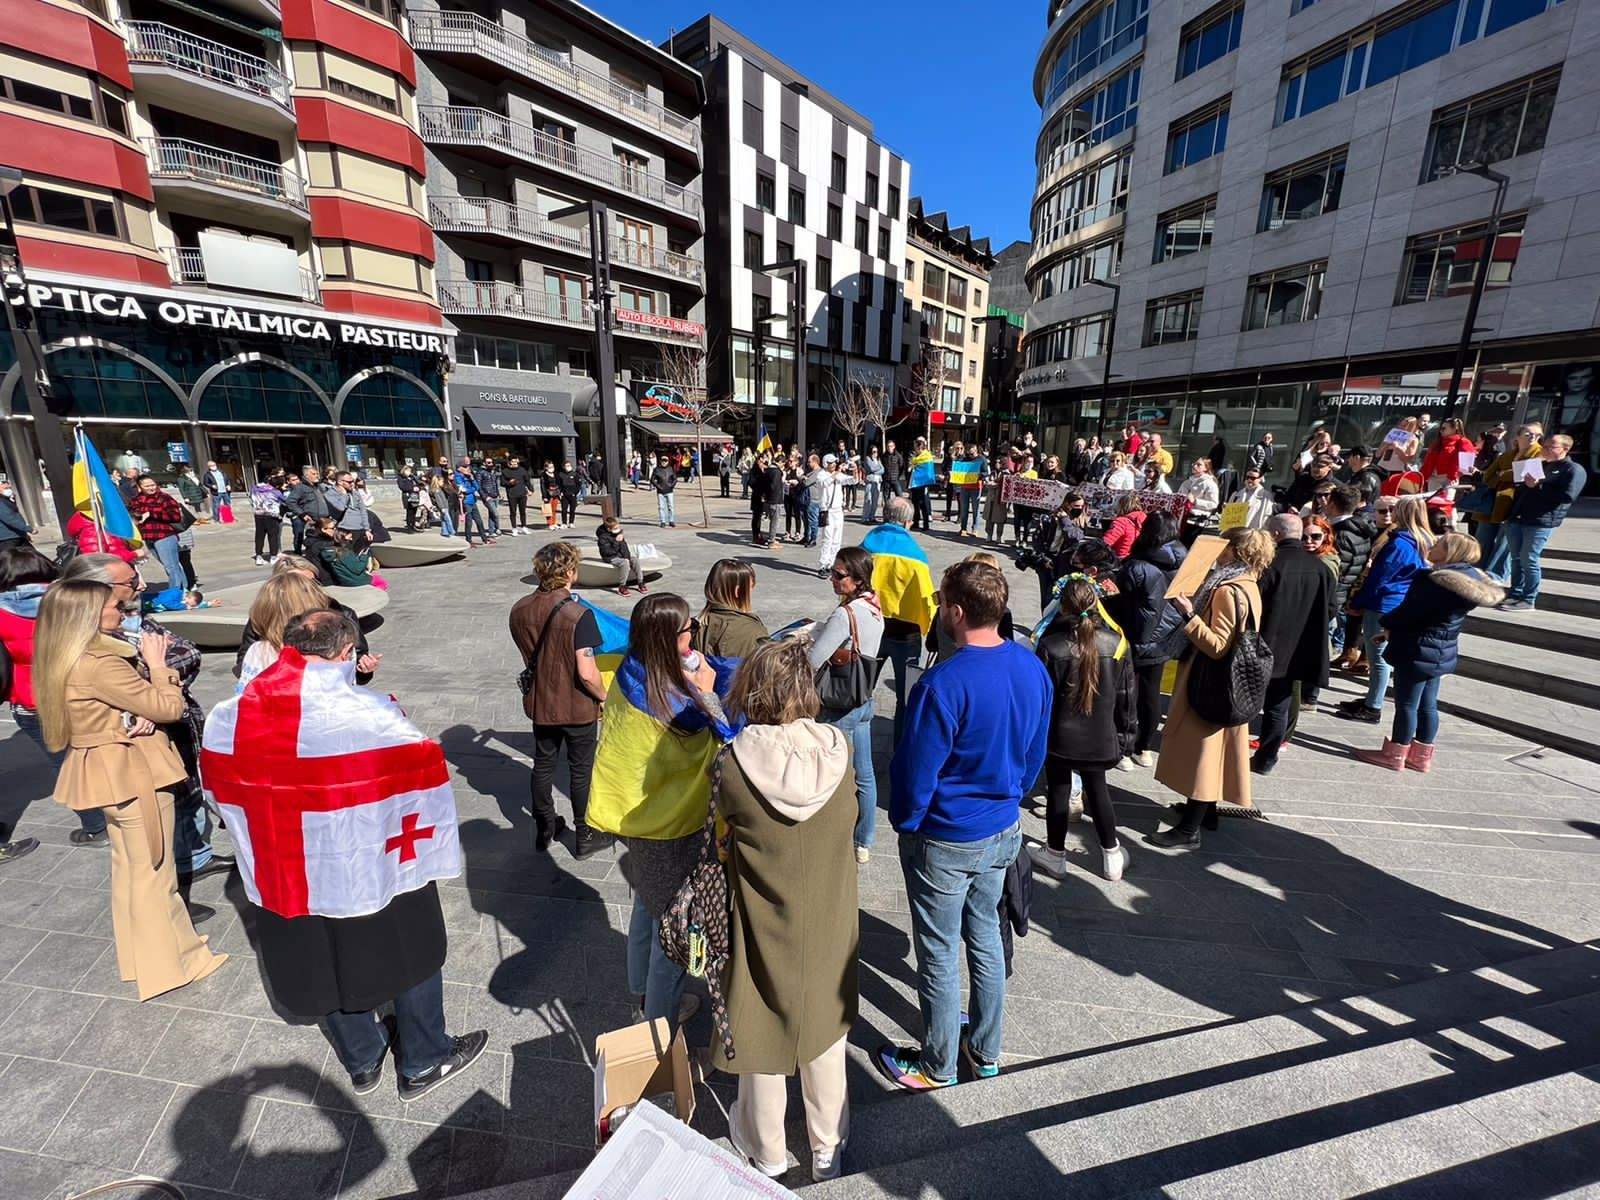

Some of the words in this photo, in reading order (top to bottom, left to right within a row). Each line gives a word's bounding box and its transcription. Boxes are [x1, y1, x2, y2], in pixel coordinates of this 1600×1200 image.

[158, 301, 331, 341] OFTÀLMICA
[340, 324, 442, 353] PASTEUR
[619, 311, 640, 320] AUTO
[642, 315, 671, 327] ESCOLA
[480, 392, 501, 402] PONS
[502, 393, 508, 402] &
[509, 394, 547, 405] BARTUMEU
